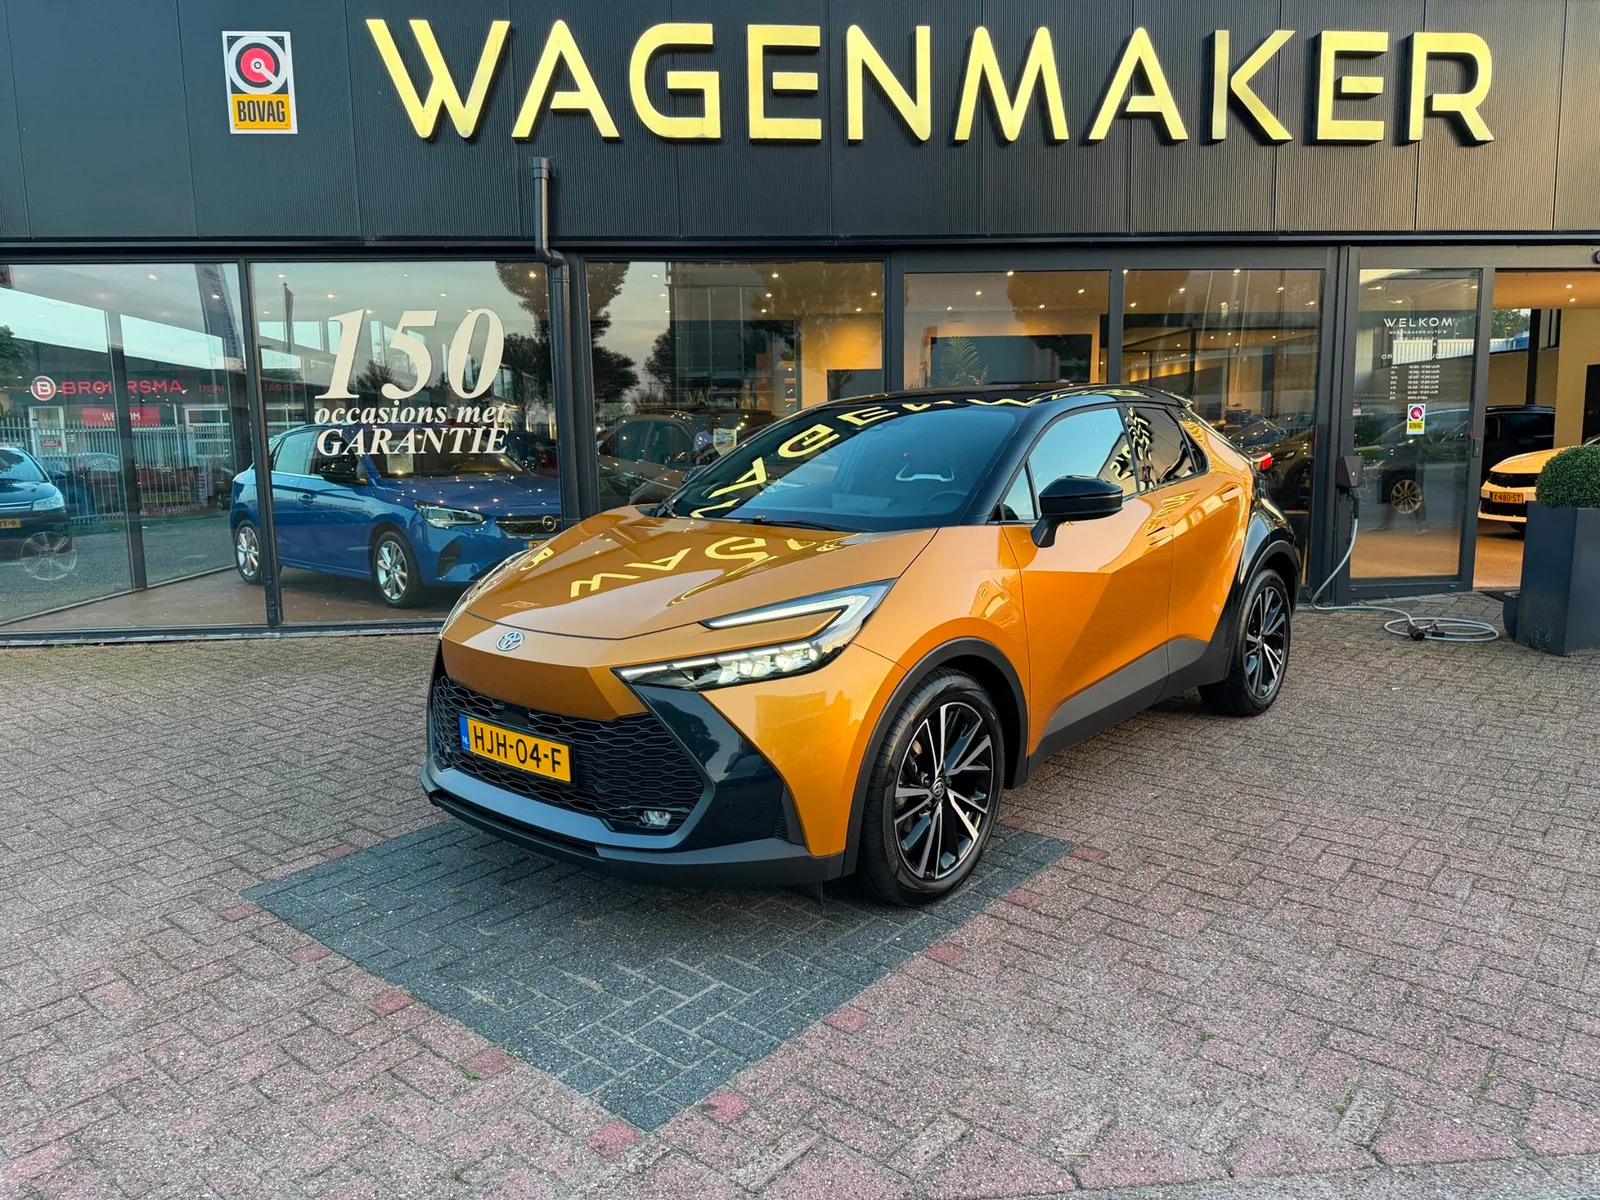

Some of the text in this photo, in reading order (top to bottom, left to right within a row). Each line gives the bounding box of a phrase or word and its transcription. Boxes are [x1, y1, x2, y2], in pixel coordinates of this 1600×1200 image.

[366, 18, 1495, 142] WAGENMAKER
[236, 100, 286, 123] BOVAG
[1383, 317, 1453, 328] WELKOM
[314, 307, 505, 400] 150
[314, 399, 507, 425] occasions met
[316, 427, 510, 456] GARANTIE
[461, 725, 562, 773] NL HJH-04-F
